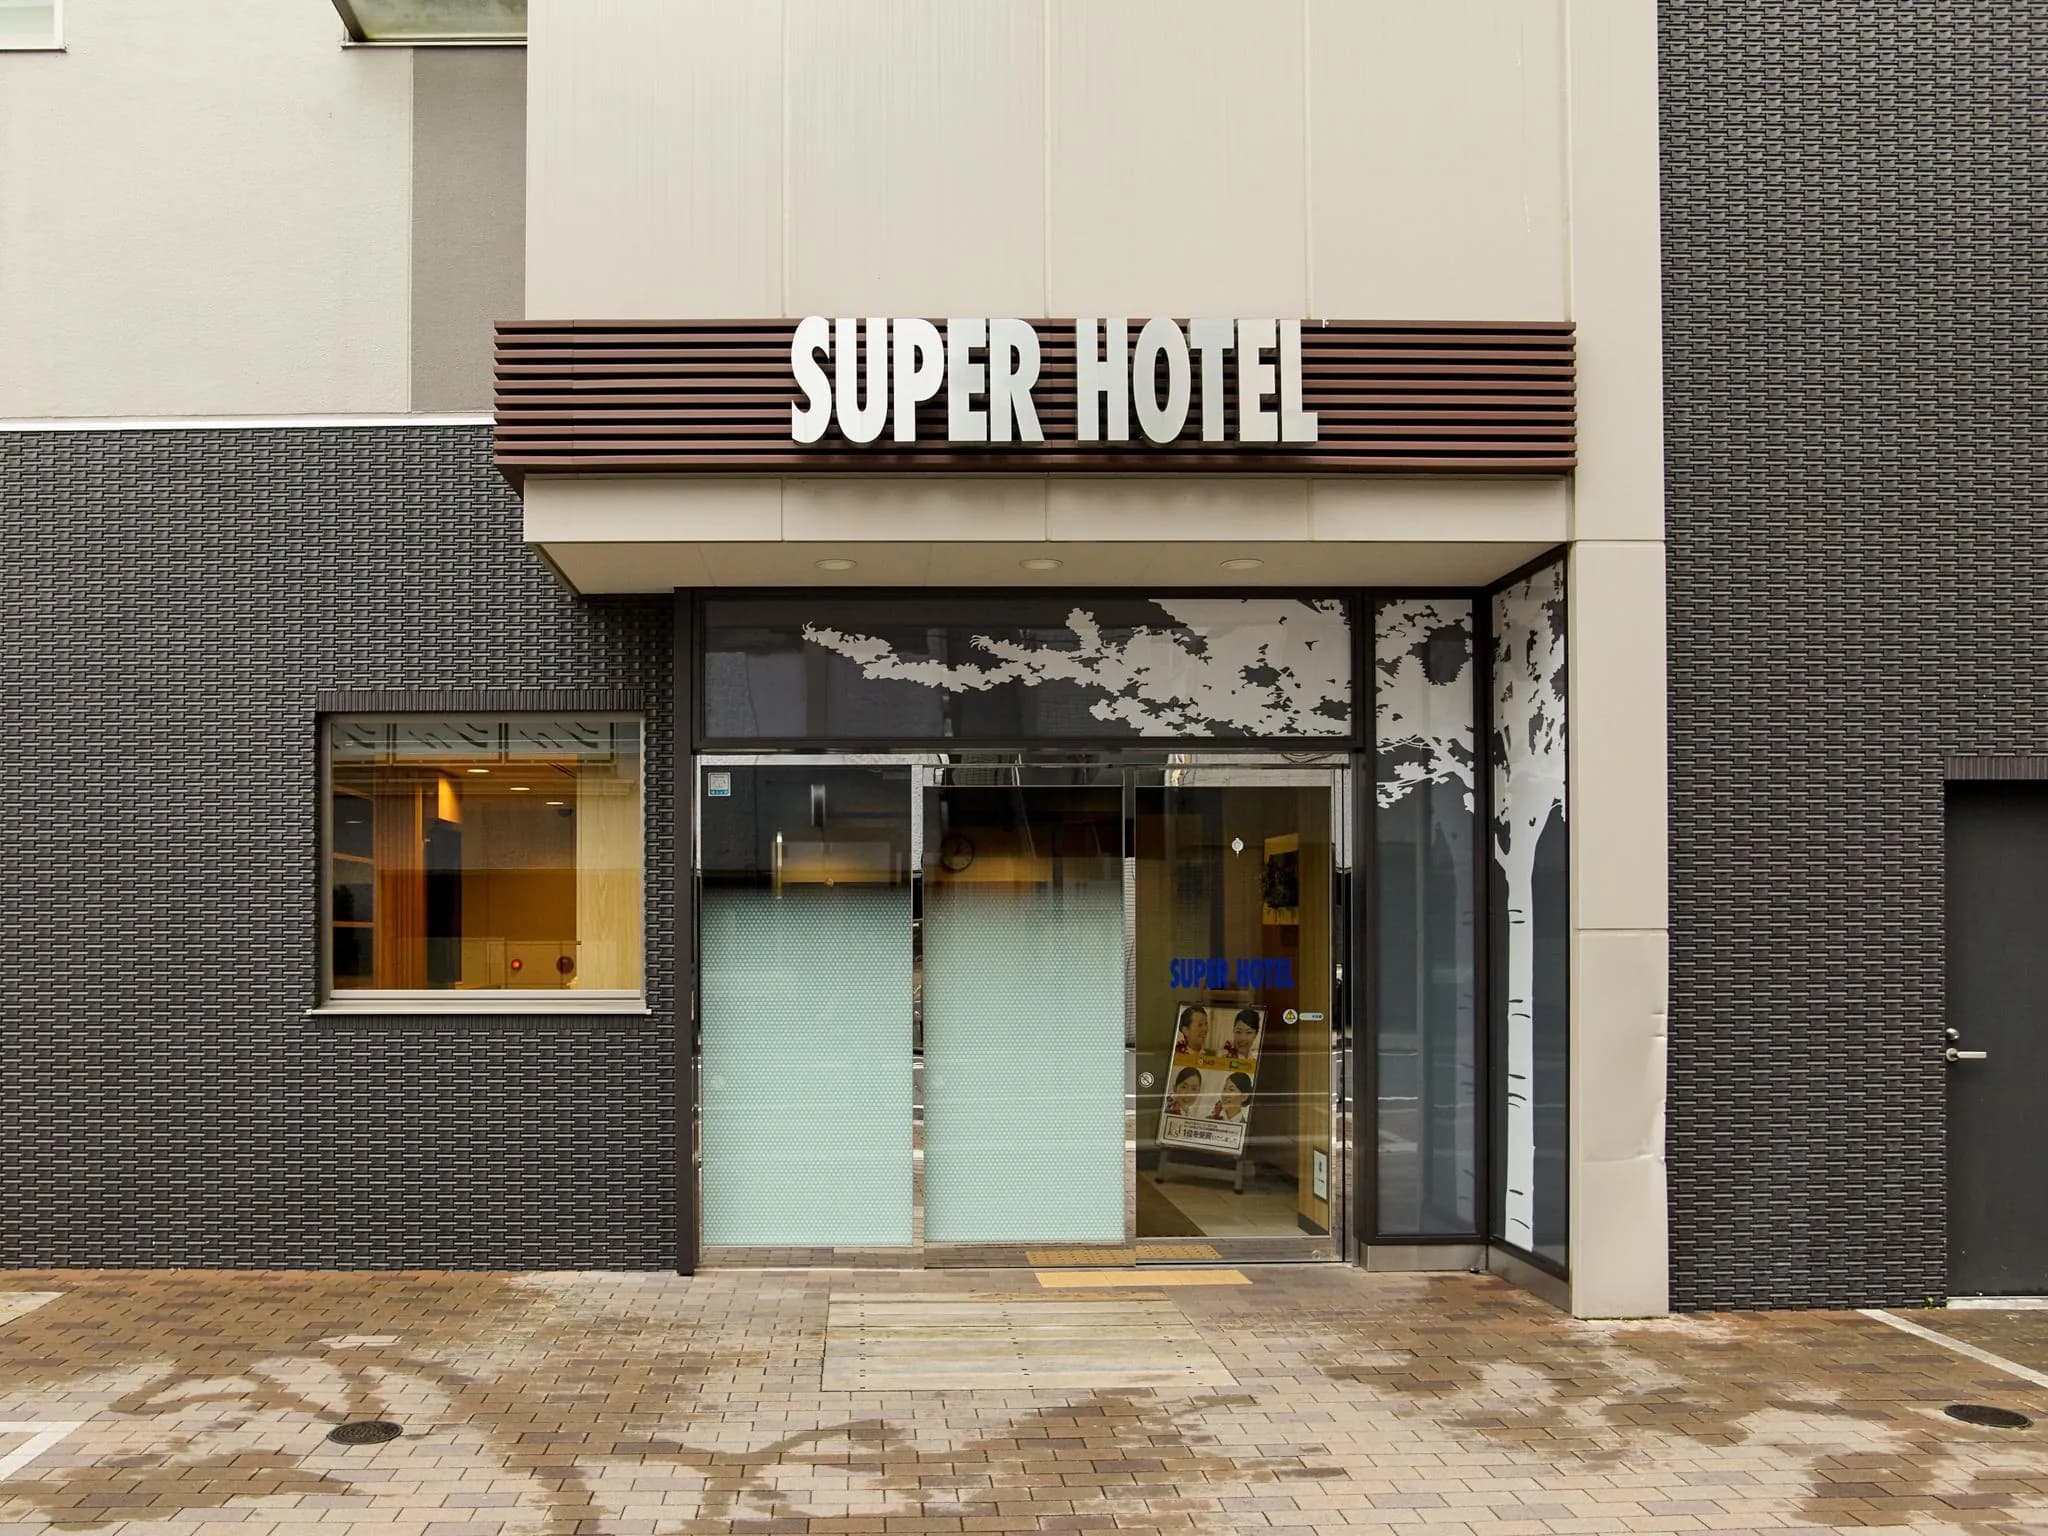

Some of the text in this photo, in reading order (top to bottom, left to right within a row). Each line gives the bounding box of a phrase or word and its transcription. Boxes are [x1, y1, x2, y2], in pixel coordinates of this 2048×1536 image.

[791, 316, 1318, 444] SUPER HOTEL
[1170, 957, 1293, 989] SUPER HOTEL
